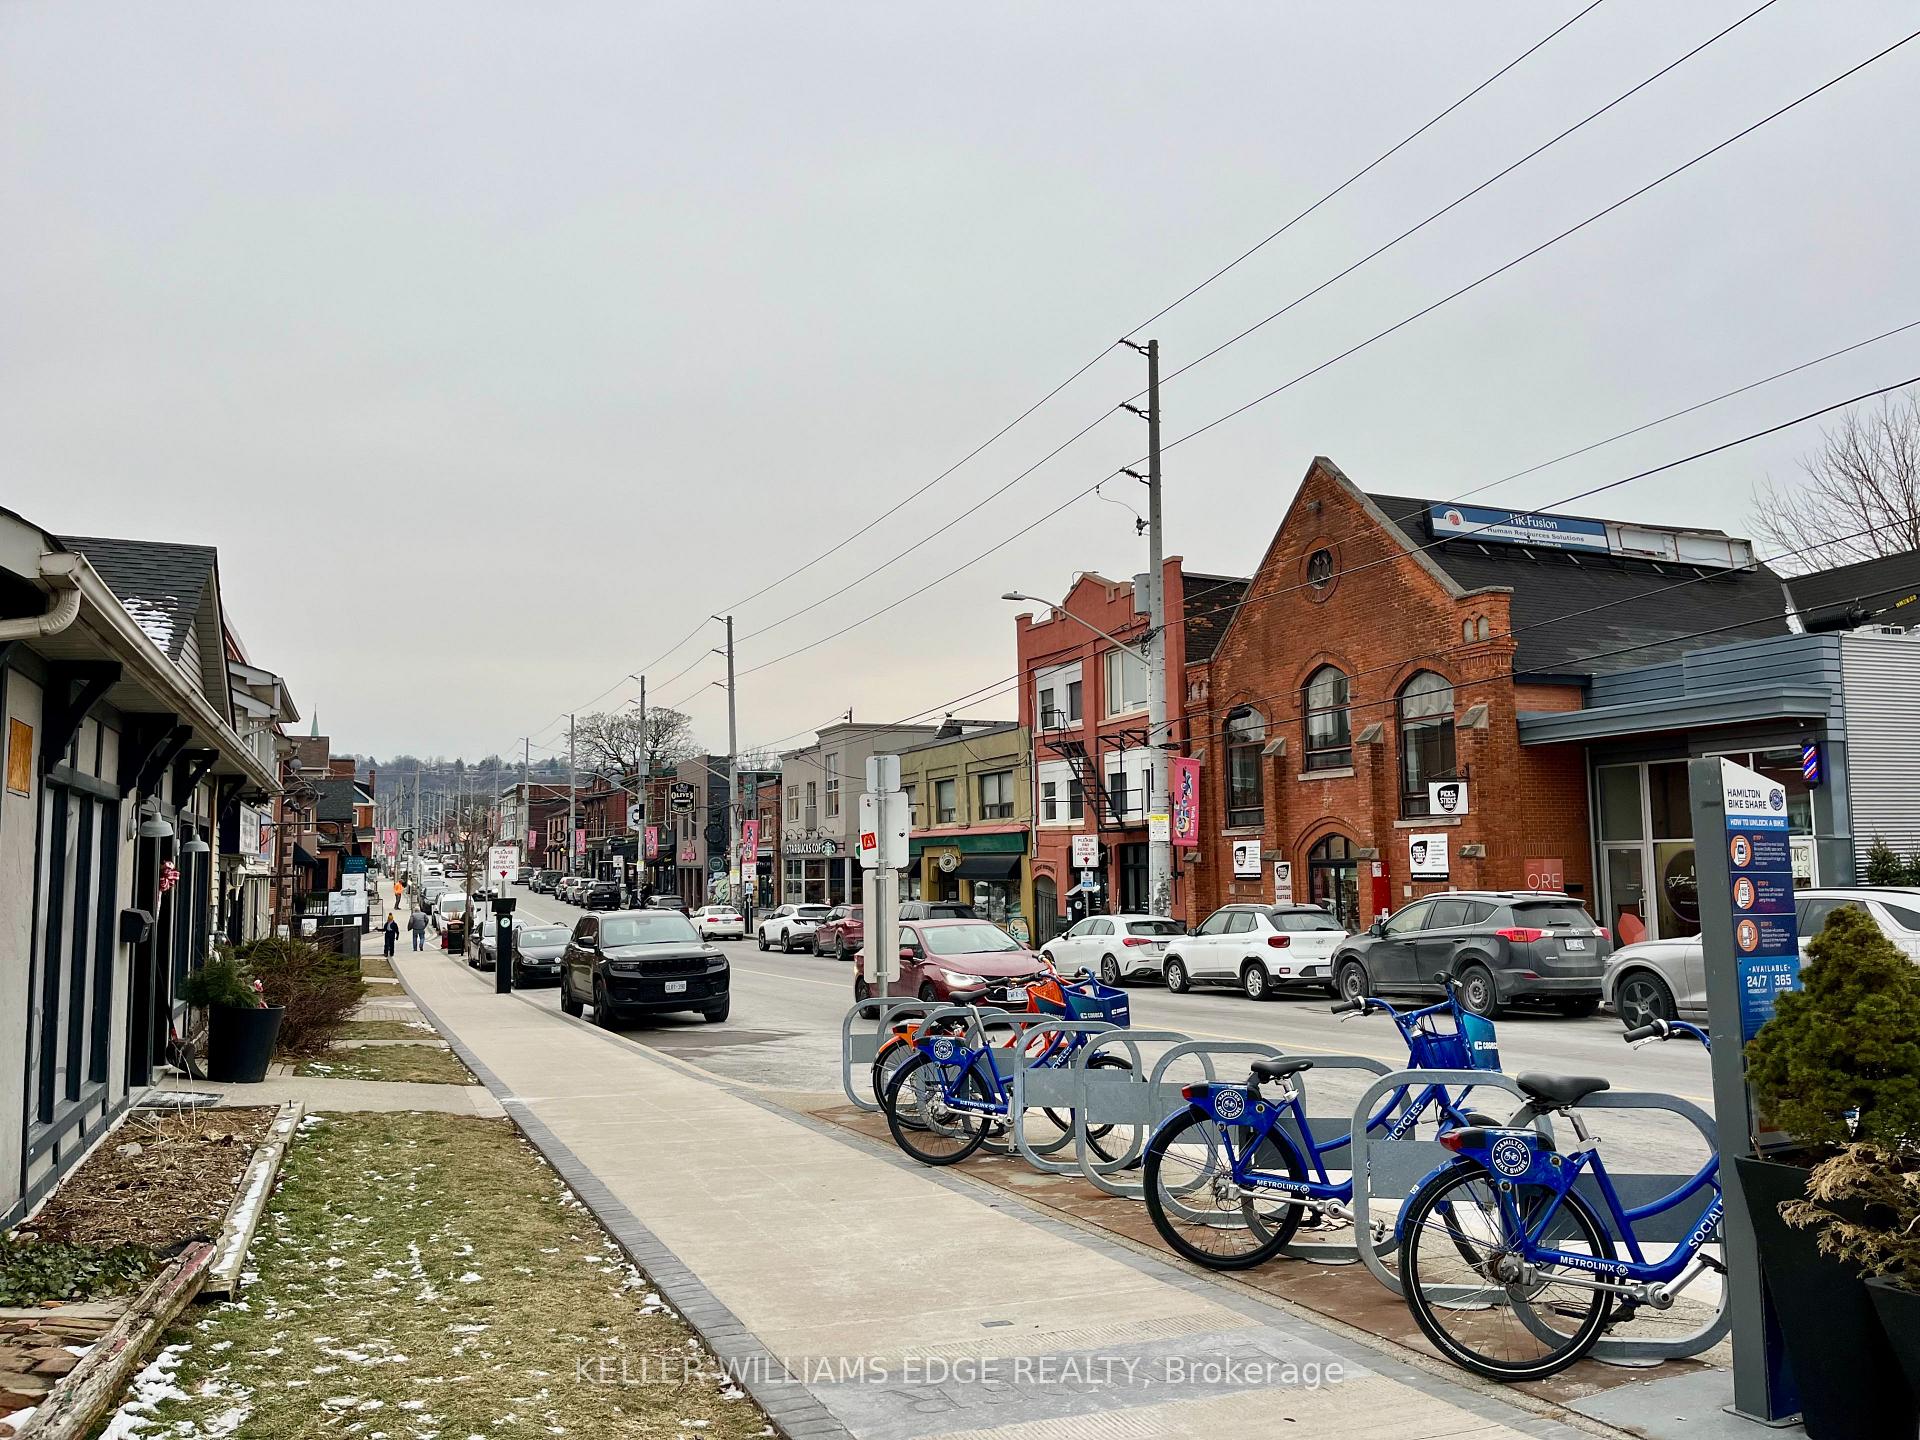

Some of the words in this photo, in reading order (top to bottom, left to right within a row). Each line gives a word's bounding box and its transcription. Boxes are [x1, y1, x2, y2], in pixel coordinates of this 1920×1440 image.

[1487, 527, 1513, 536] Human
[1514, 529, 1550, 539] Resources
[1551, 533, 1585, 543] Solutions
[671, 791, 694, 800] OLIVE'S
[1727, 788, 1761, 799] HAMILTON
[1728, 799, 1744, 809] BIKE
[1745, 800, 1767, 810] SHARE
[1730, 818, 1742, 827] HOW
[1749, 818, 1769, 827] UNLOCK
[786, 842, 812, 854] STARBUCKS
[1527, 873, 1562, 889] ORE
[1751, 964, 1788, 973] AVAILABLE
[1746, 974, 1768, 988] 24/7
[1774, 974, 1792, 986] 365
[960, 1099, 989, 1109] METROLINX
[1495, 1139, 1527, 1153] HAMILTON
[1509, 1159, 1528, 1174] SHARE
[1256, 1179, 1299, 1191] METROLINX
[1559, 1255, 1615, 1273] METROLINX
